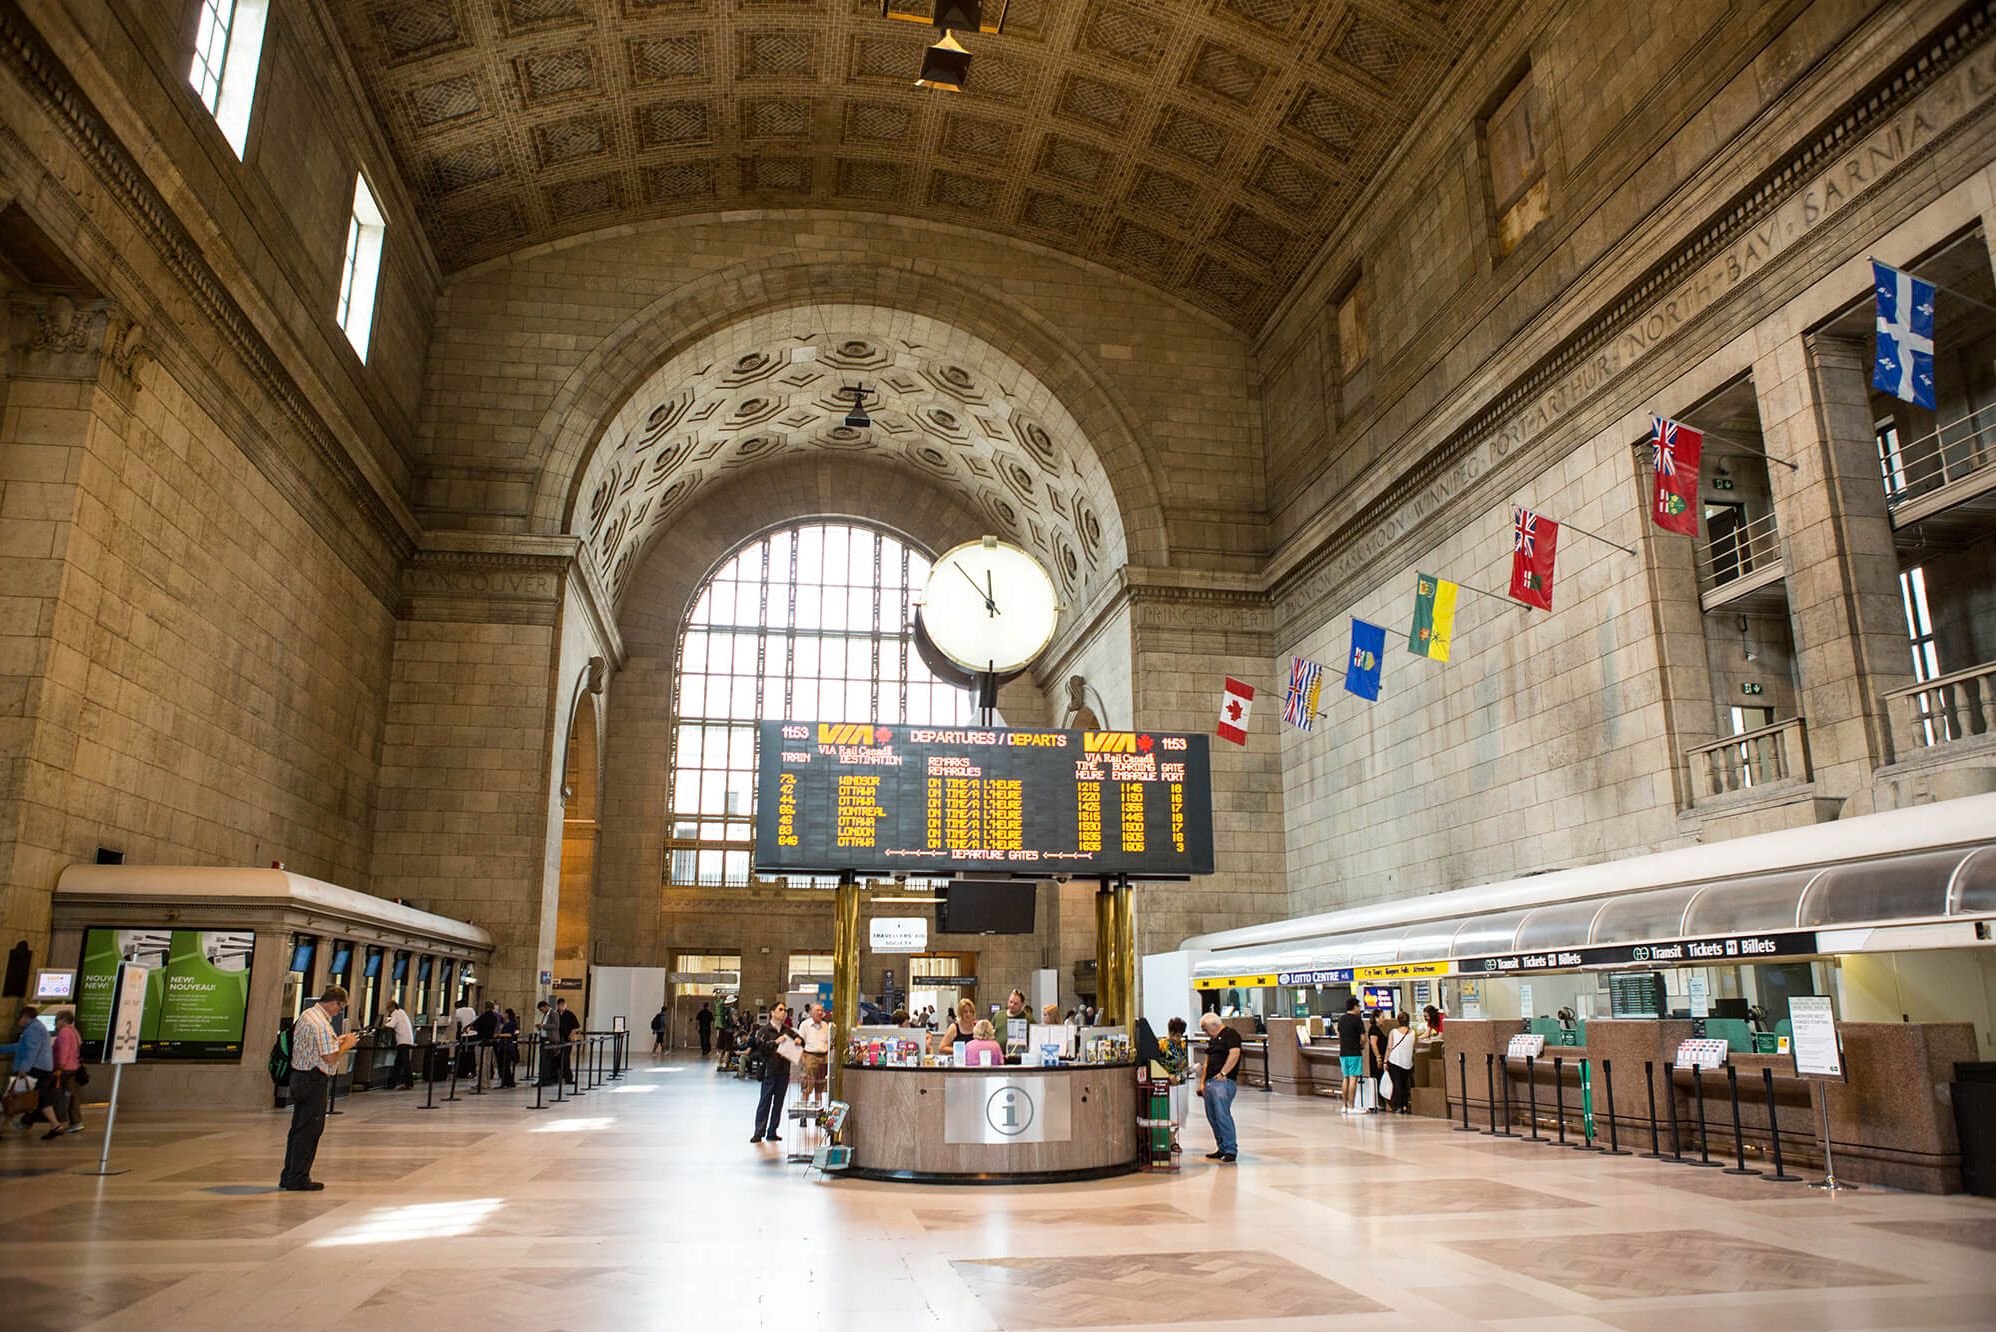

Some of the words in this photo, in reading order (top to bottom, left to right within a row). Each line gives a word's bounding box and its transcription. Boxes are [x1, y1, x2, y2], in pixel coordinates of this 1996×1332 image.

[1413, 456, 1479, 517] WINNIPEG
[1803, 113, 1936, 228] SARNIA
[408, 574, 547, 593] VANCOUVER
[818, 724, 874, 745] VIA
[910, 730, 996, 745] DEPARTURES
[1008, 733, 1067, 747] DEPARTS
[1084, 732, 1136, 752] VIA
[781, 752, 811, 762] TRAIN
[818, 745, 837, 754] VIA
[838, 746, 858, 756] Rail
[1085, 752, 1102, 762] VIA
[1104, 753, 1121, 762] Rail
[840, 755, 903, 765] DESTINATION
[928, 756, 970, 767] REMARKS
[1075, 761, 1098, 770] TIME
[1112, 762, 1156, 772] BOARDING
[928, 766, 982, 776] REMARQUES
[1161, 763, 1184, 772] GATE
[1075, 771, 1105, 780] HEURE
[1112, 772, 1158, 780] EMBARQUE
[1161, 772, 1184, 782] PORT
[838, 776, 880, 786] WINDSOR
[928, 778, 942, 788] ON
[945, 778, 980, 788] TIME/A
[984, 780, 1022, 790] L'HEURE
[1078, 782, 1100, 792] 1215
[1121, 783, 1143, 792] 1145
[1171, 784, 1182, 793] 18
[780, 784, 794, 794] 42
[838, 786, 876, 796] OTTAWA
[928, 788, 942, 798] ON
[945, 788, 980, 799] TIME/A
[984, 790, 1022, 800] L'HEURE
[1078, 792, 1100, 802] 1220
[1121, 793, 1144, 802] 1150
[838, 796, 876, 806] OTTAWA
[928, 799, 942, 808] ON
[945, 799, 980, 809] TIME/A
[984, 800, 1022, 810] L'HEURE
[1078, 802, 1100, 812] 1425
[1172, 804, 1182, 812] 17
[838, 806, 886, 816] MONTREAL
[928, 808, 942, 818] ON
[945, 808, 980, 819] TIME/A
[984, 810, 1022, 820] L'HEURE
[1078, 812, 1100, 822] 1515
[1122, 812, 1144, 822] 1445
[1172, 813, 1183, 822] 18
[838, 817, 875, 827] OTTAWA
[928, 819, 942, 828] ON
[945, 819, 980, 829] TIME/A
[984, 820, 1022, 830] L'HEURE
[1079, 822, 1101, 832] 1530
[1172, 823, 1183, 832] 17
[838, 826, 875, 836] LONDON
[928, 829, 942, 838] ON
[945, 829, 980, 839] TIME/A
[984, 830, 1022, 840] L'HEURE
[837, 837, 875, 847] OTTAWA
[928, 839, 942, 848] ON
[945, 839, 980, 849] TIME/A
[984, 840, 1022, 850] L'HEURE
[1176, 842, 1184, 852] 3
[952, 850, 1004, 860] DEPARTURE
[1008, 850, 1039, 860] GATES
[1650, 944, 1683, 959] Transit
[1688, 942, 1722, 958] Tickets
[1741, 939, 1776, 954] Billets
[1498, 958, 1520, 969] Transit
[1522, 954, 1546, 968] Tickets
[1558, 952, 1582, 966] Billets
